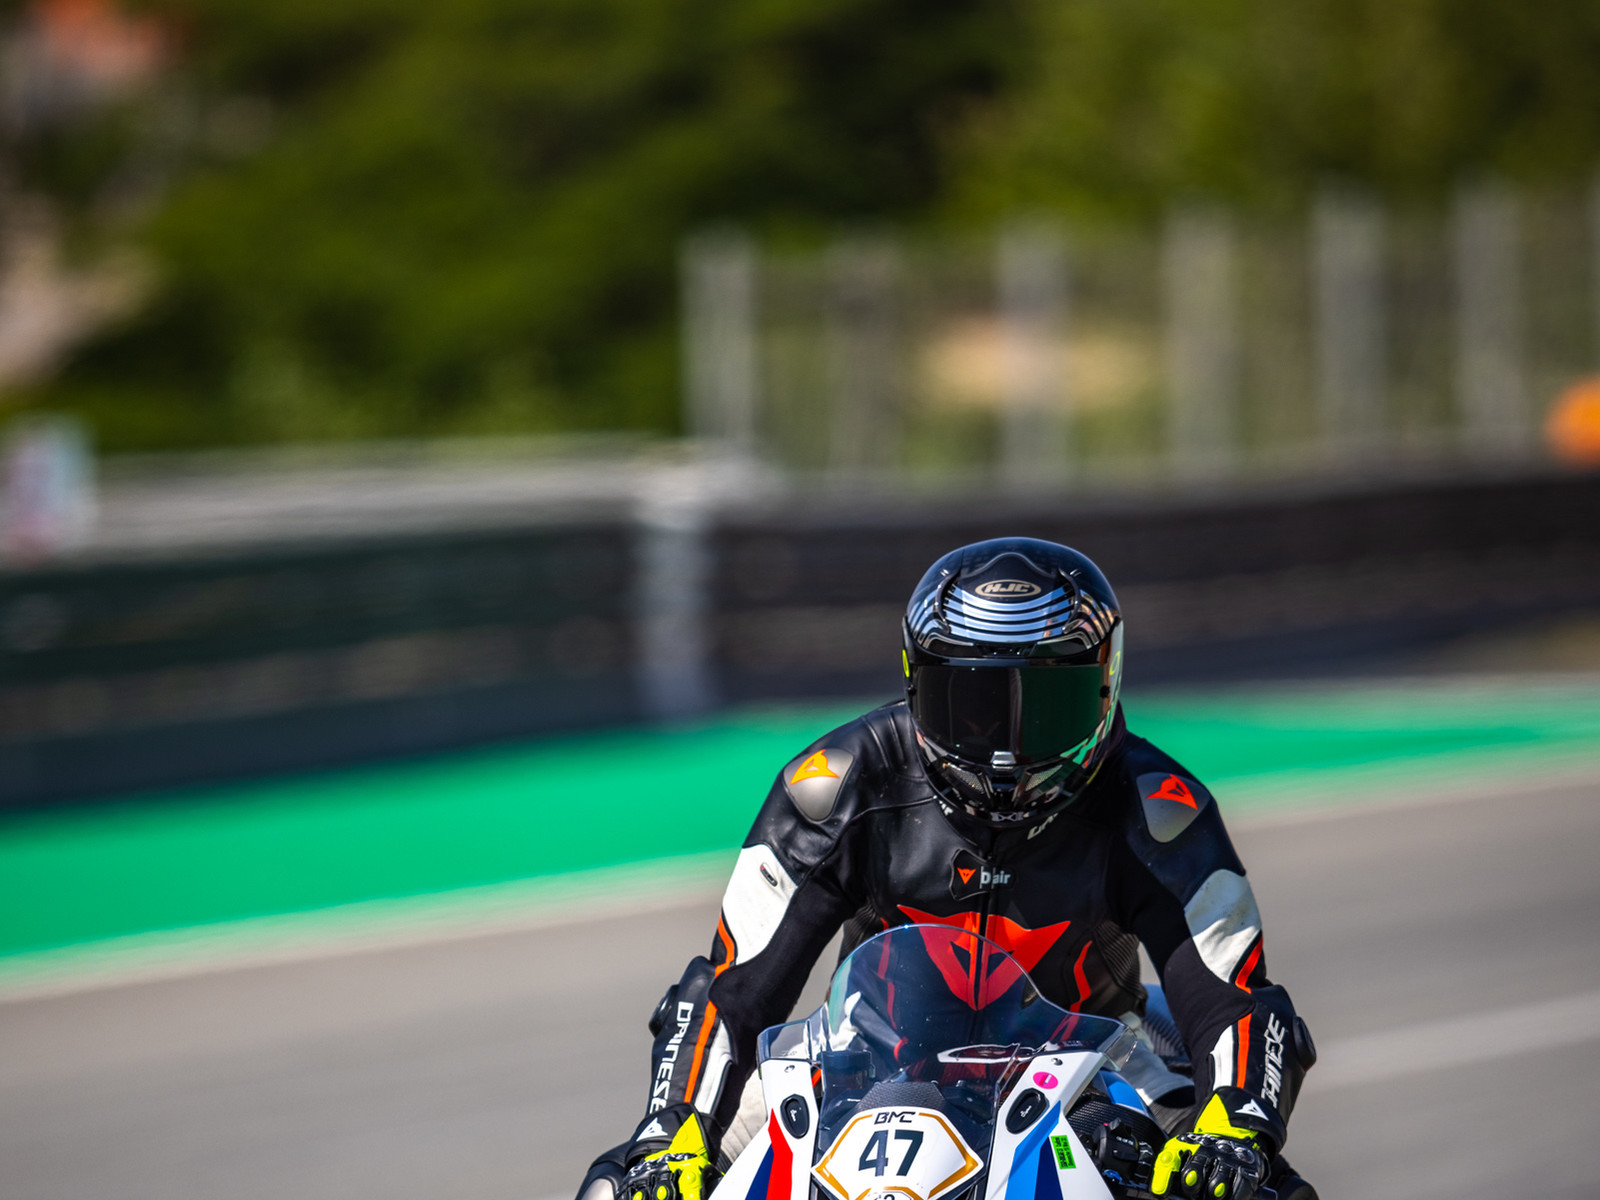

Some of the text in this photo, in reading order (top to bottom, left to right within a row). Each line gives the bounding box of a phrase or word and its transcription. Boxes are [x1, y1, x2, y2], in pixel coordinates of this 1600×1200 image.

[984, 583, 1030, 593] HJC
[649, 1001, 695, 1115] DAINESE
[873, 1111, 916, 1125] BMC
[858, 1129, 924, 1177] 47
